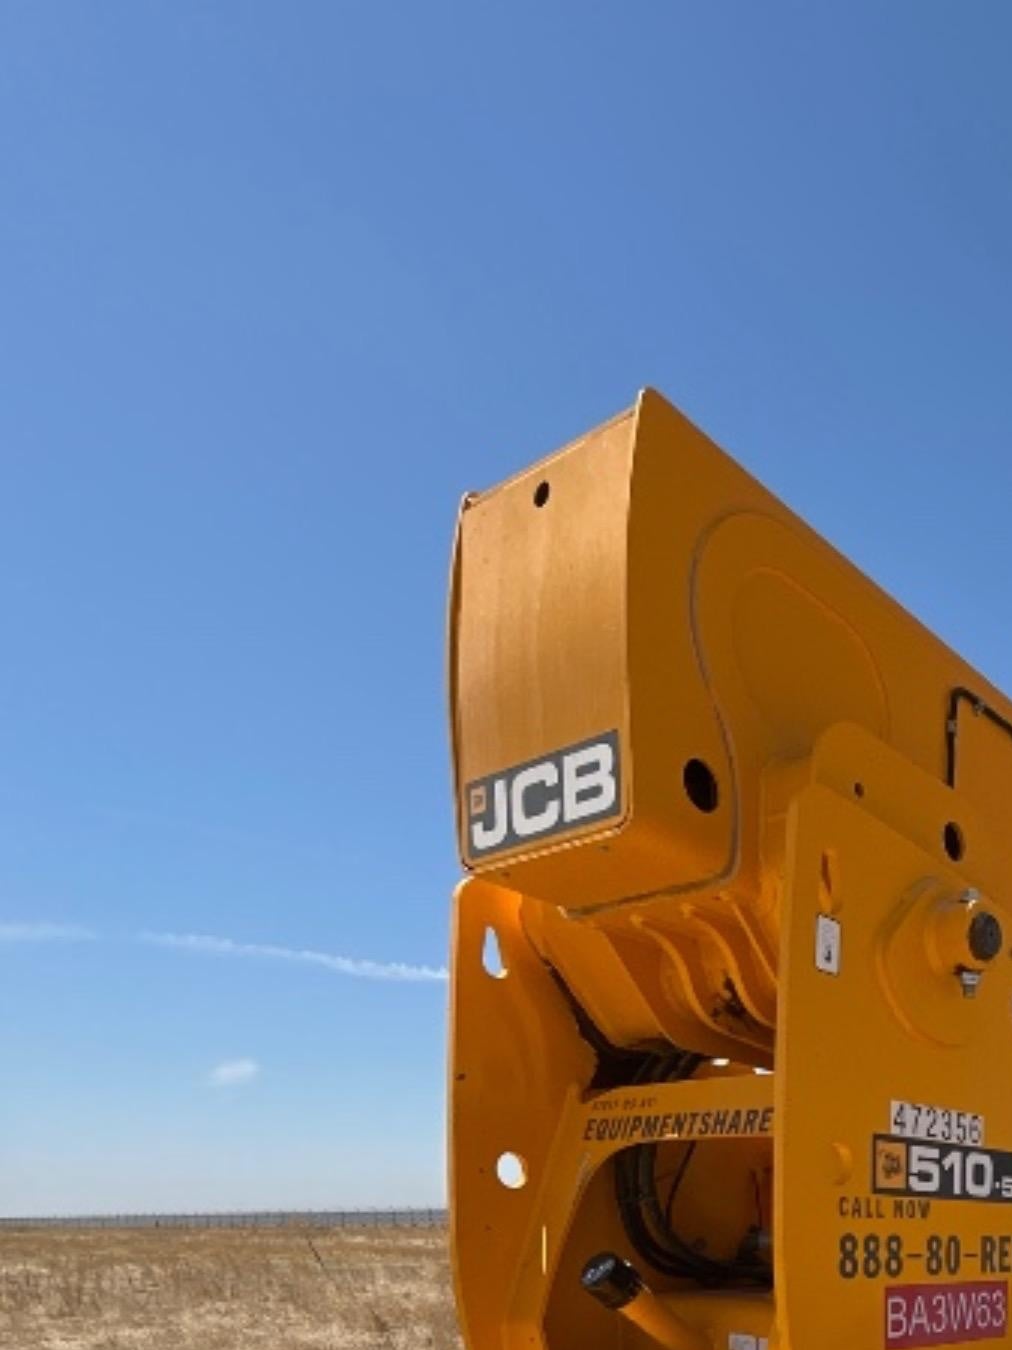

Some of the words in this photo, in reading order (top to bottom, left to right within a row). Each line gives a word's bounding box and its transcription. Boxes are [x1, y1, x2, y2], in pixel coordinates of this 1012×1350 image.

[472, 743, 616, 850] JCB
[584, 1107, 774, 1140] EQUIPMENTSHARE
[893, 1103, 982, 1144] 472356
[838, 1196, 885, 1219] CALL
[893, 1199, 931, 1219] NOW
[886, 1288, 1007, 1339] BA3W63
